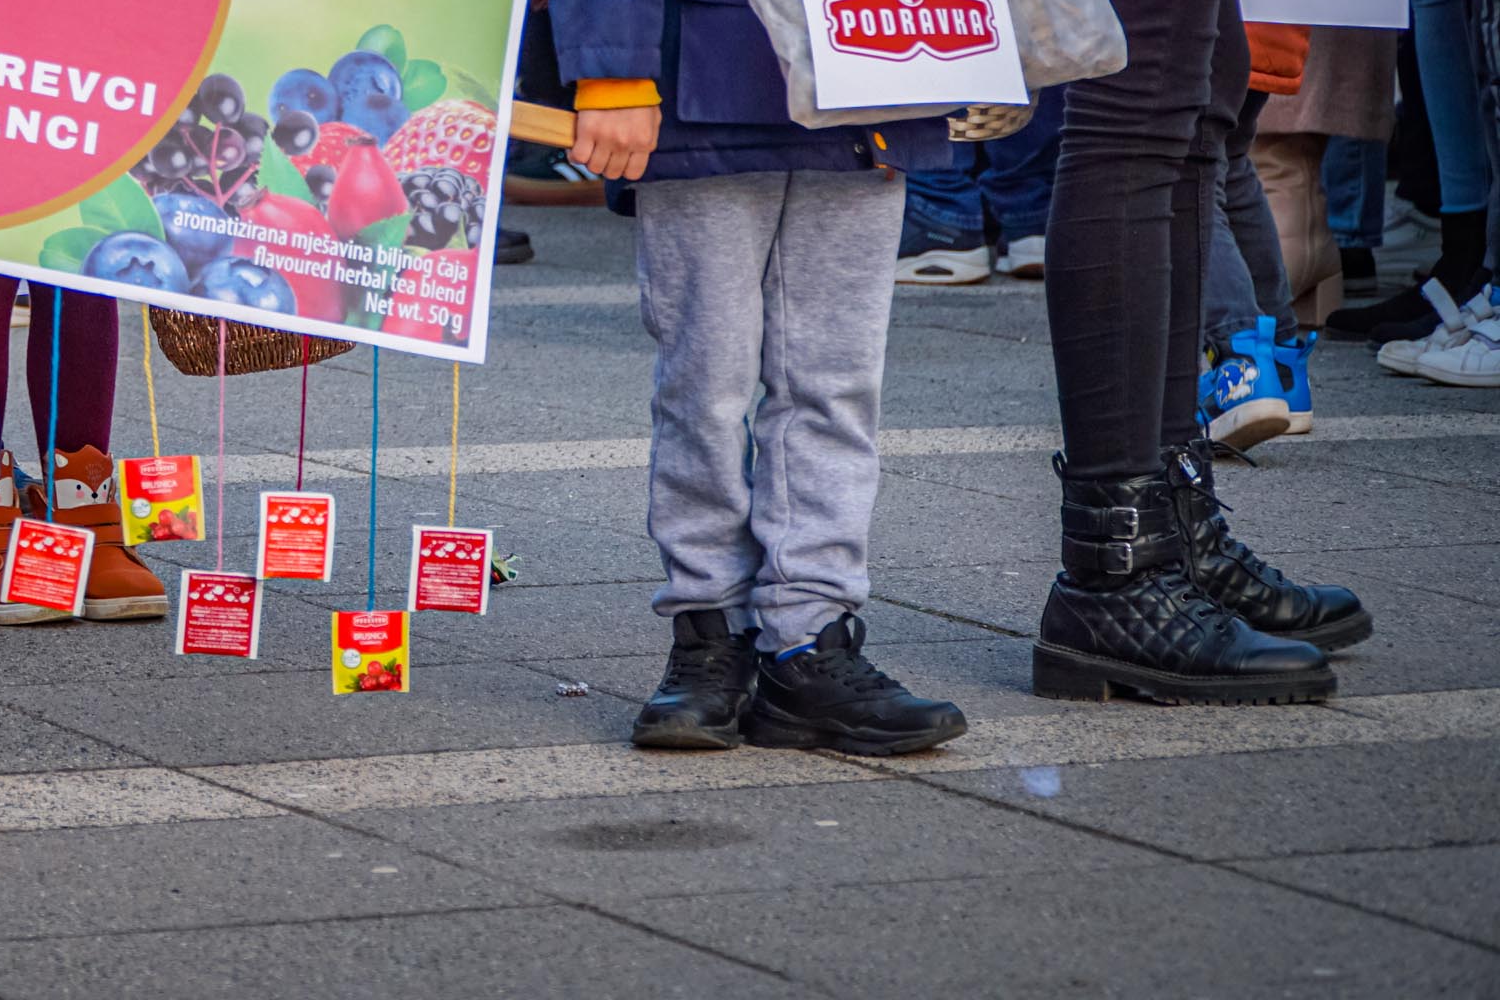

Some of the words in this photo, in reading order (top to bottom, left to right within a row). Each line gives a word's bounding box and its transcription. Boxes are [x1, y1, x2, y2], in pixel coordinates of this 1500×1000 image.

[839, 7, 986, 38] PODRAVKA
[173, 210, 289, 244] aromatizirana
[290, 231, 373, 264] mješavina
[376, 244, 434, 278] biljnog
[436, 257, 469, 284] čaja
[253, 246, 331, 280] flavoured
[334, 260, 387, 290] herbal
[390, 273, 416, 295] tea
[419, 278, 467, 306] blend
[364, 291, 394, 317] Net
[397, 300, 424, 322] wt.
[427, 304, 449, 328] 50
[451, 313, 463, 335] g
